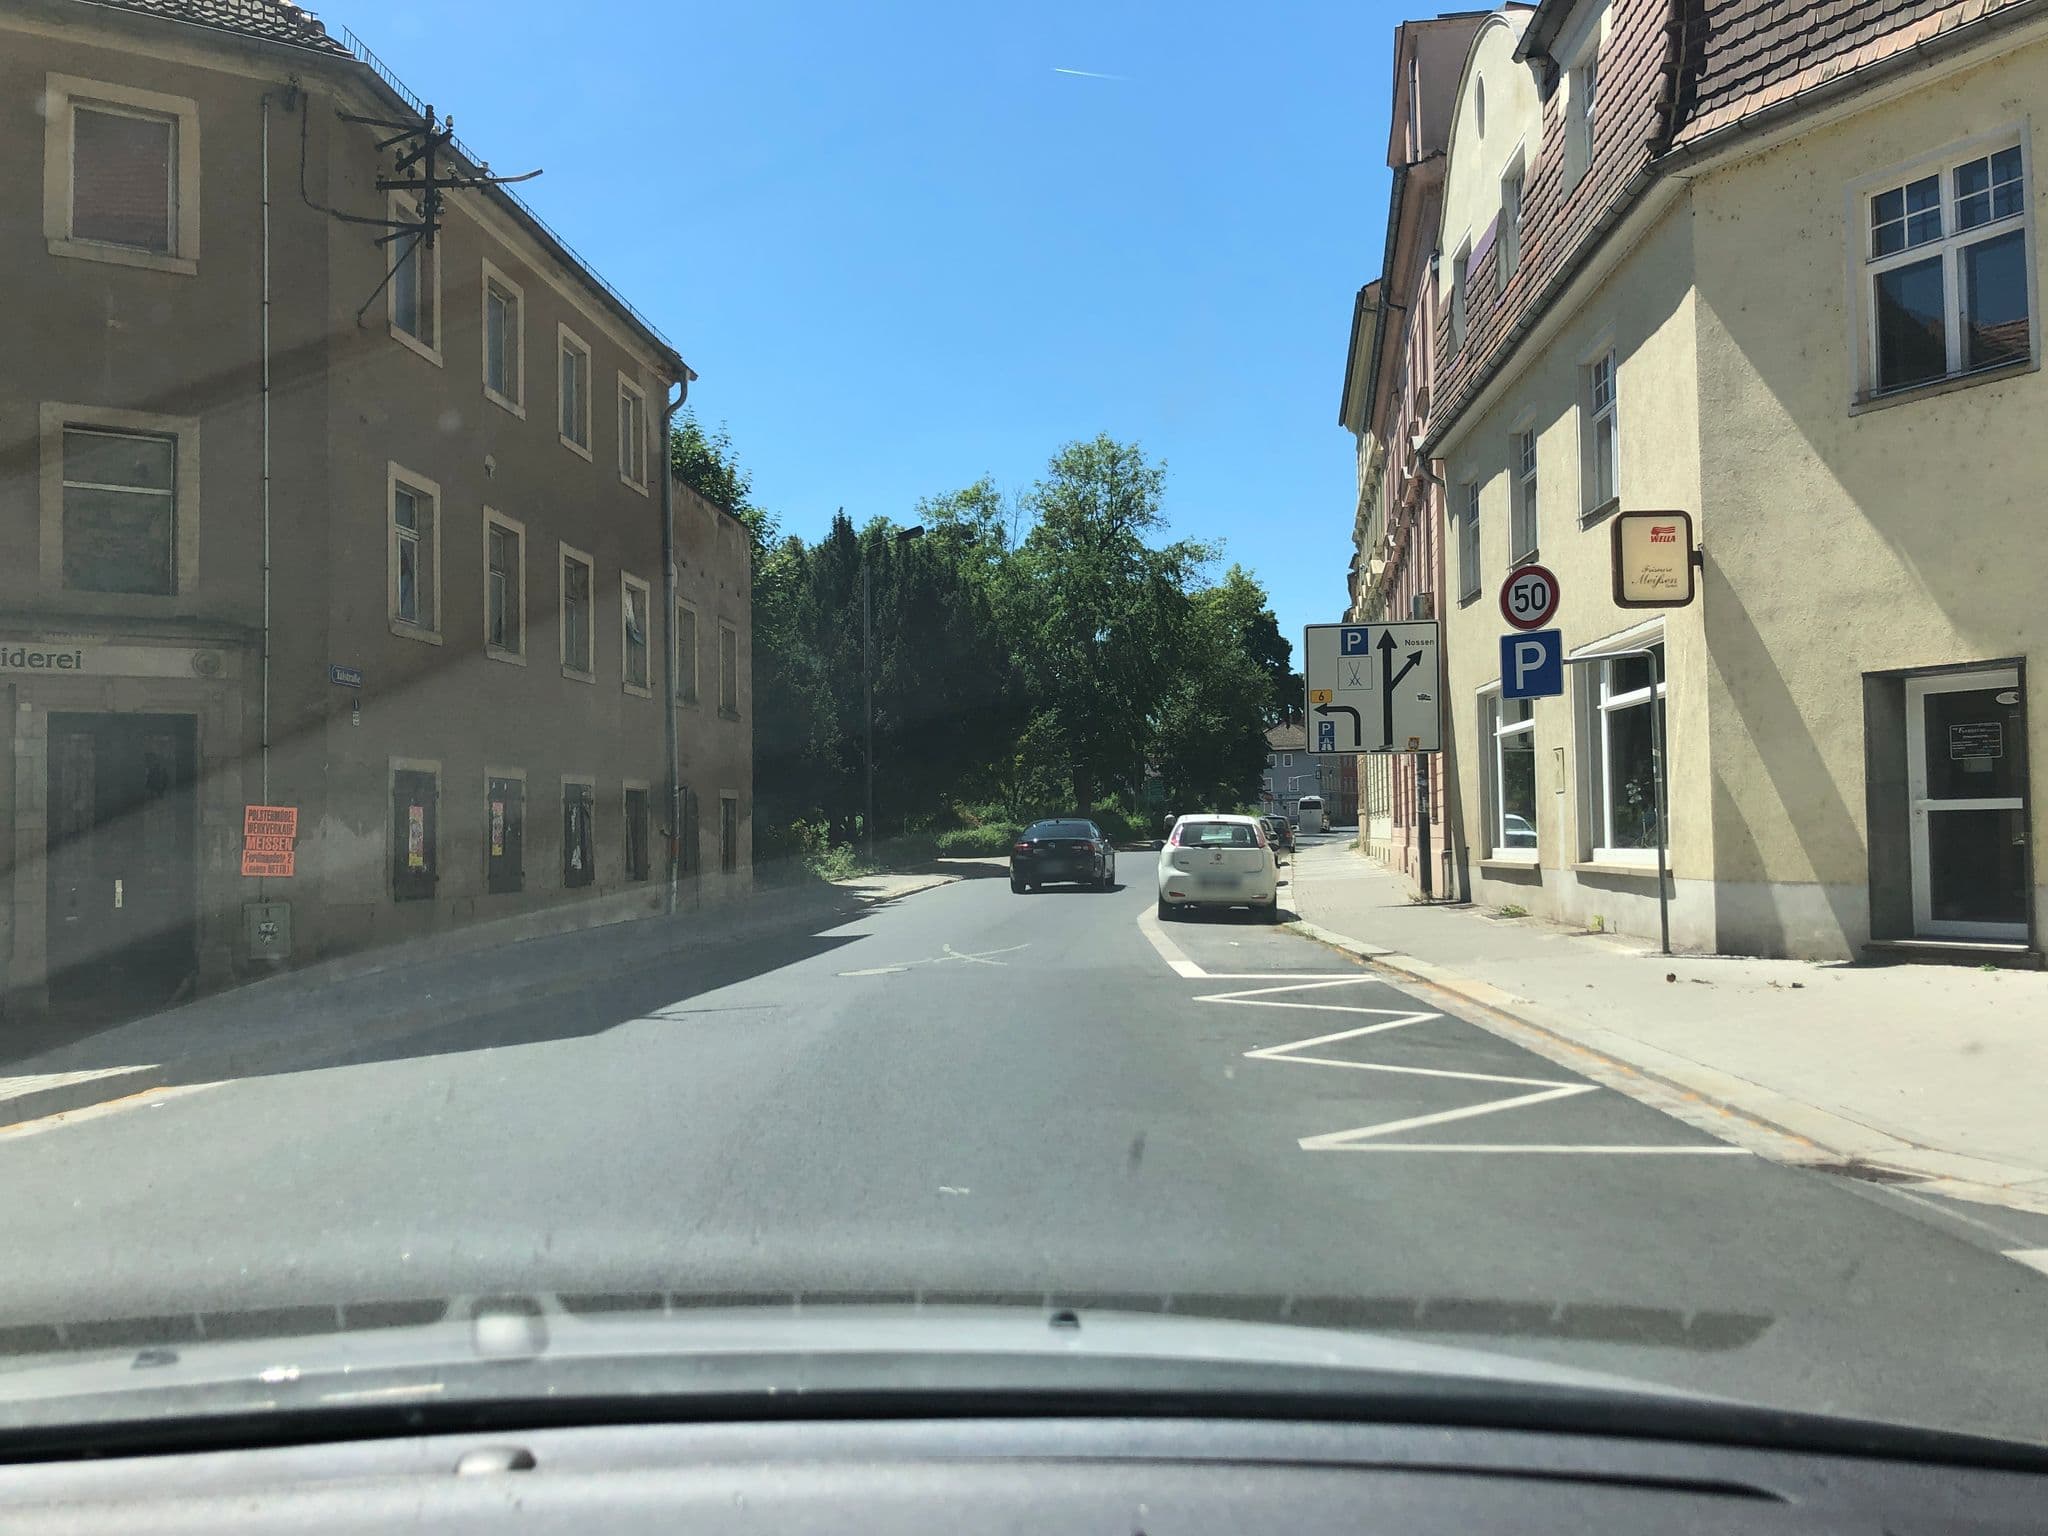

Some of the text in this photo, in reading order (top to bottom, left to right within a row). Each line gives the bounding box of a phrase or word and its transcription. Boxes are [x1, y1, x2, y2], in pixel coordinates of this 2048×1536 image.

[1651, 535, 1675, 543] WELLA
[1632, 574, 1678, 588] Meißen
[1514, 582, 1546, 613] 50
[1347, 632, 1361, 652] P
[1404, 639, 1435, 647] Nossen
[1515, 641, 1547, 690] P
[1318, 691, 1325, 701] 6
[1321, 723, 1331, 735] P
[246, 836, 293, 850] MEISSEN
